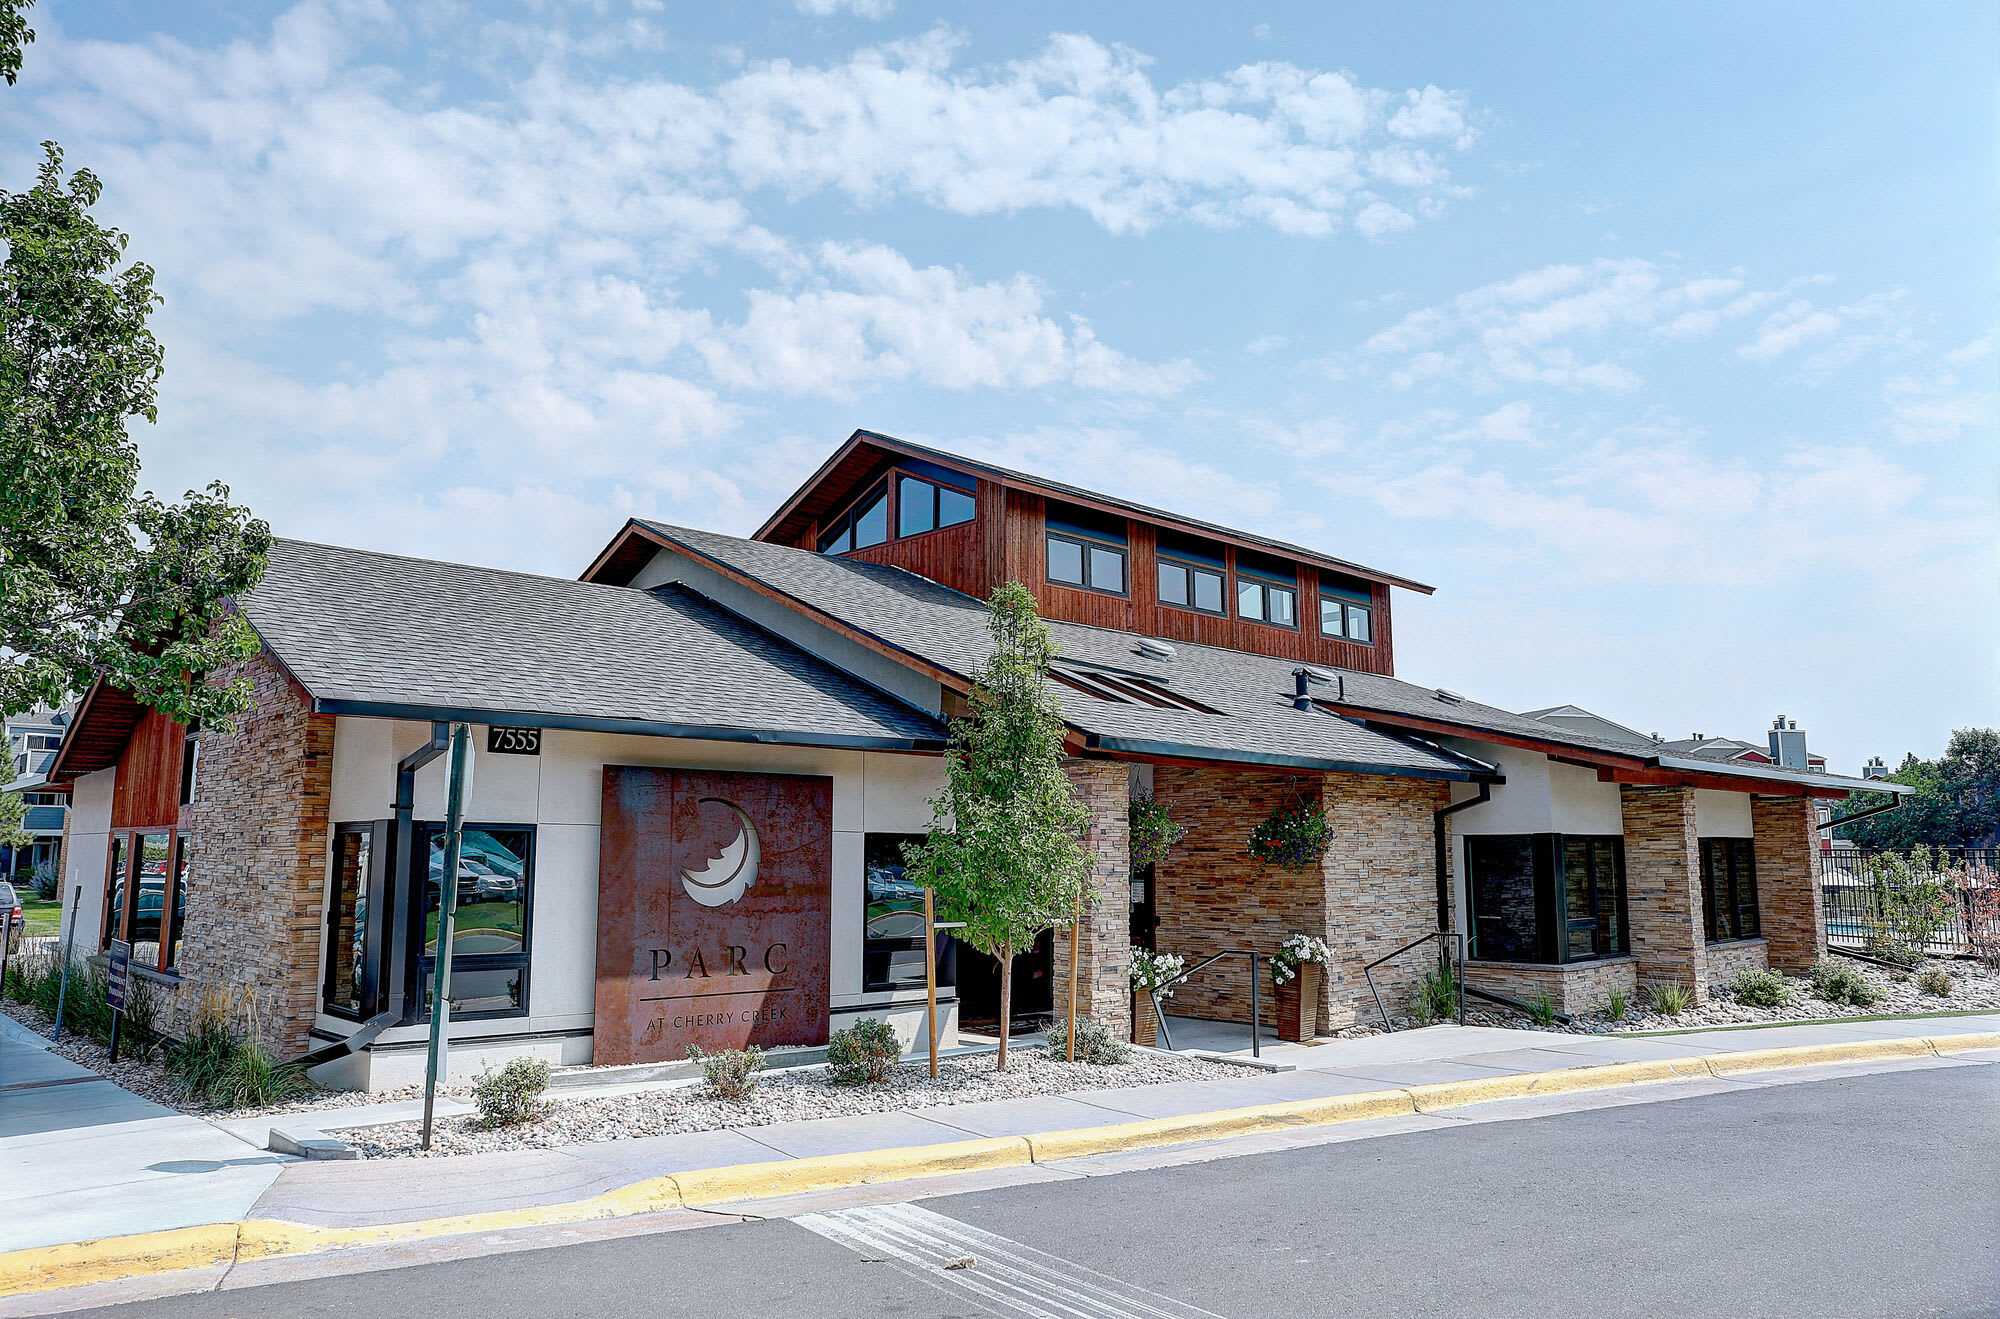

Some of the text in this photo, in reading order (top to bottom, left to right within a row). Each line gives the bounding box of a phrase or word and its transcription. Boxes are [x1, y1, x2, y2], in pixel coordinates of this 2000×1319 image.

[493, 728, 538, 750] 7555
[648, 943, 788, 981] PARC
[646, 1007, 788, 1031] AT CHERRY CREEK
